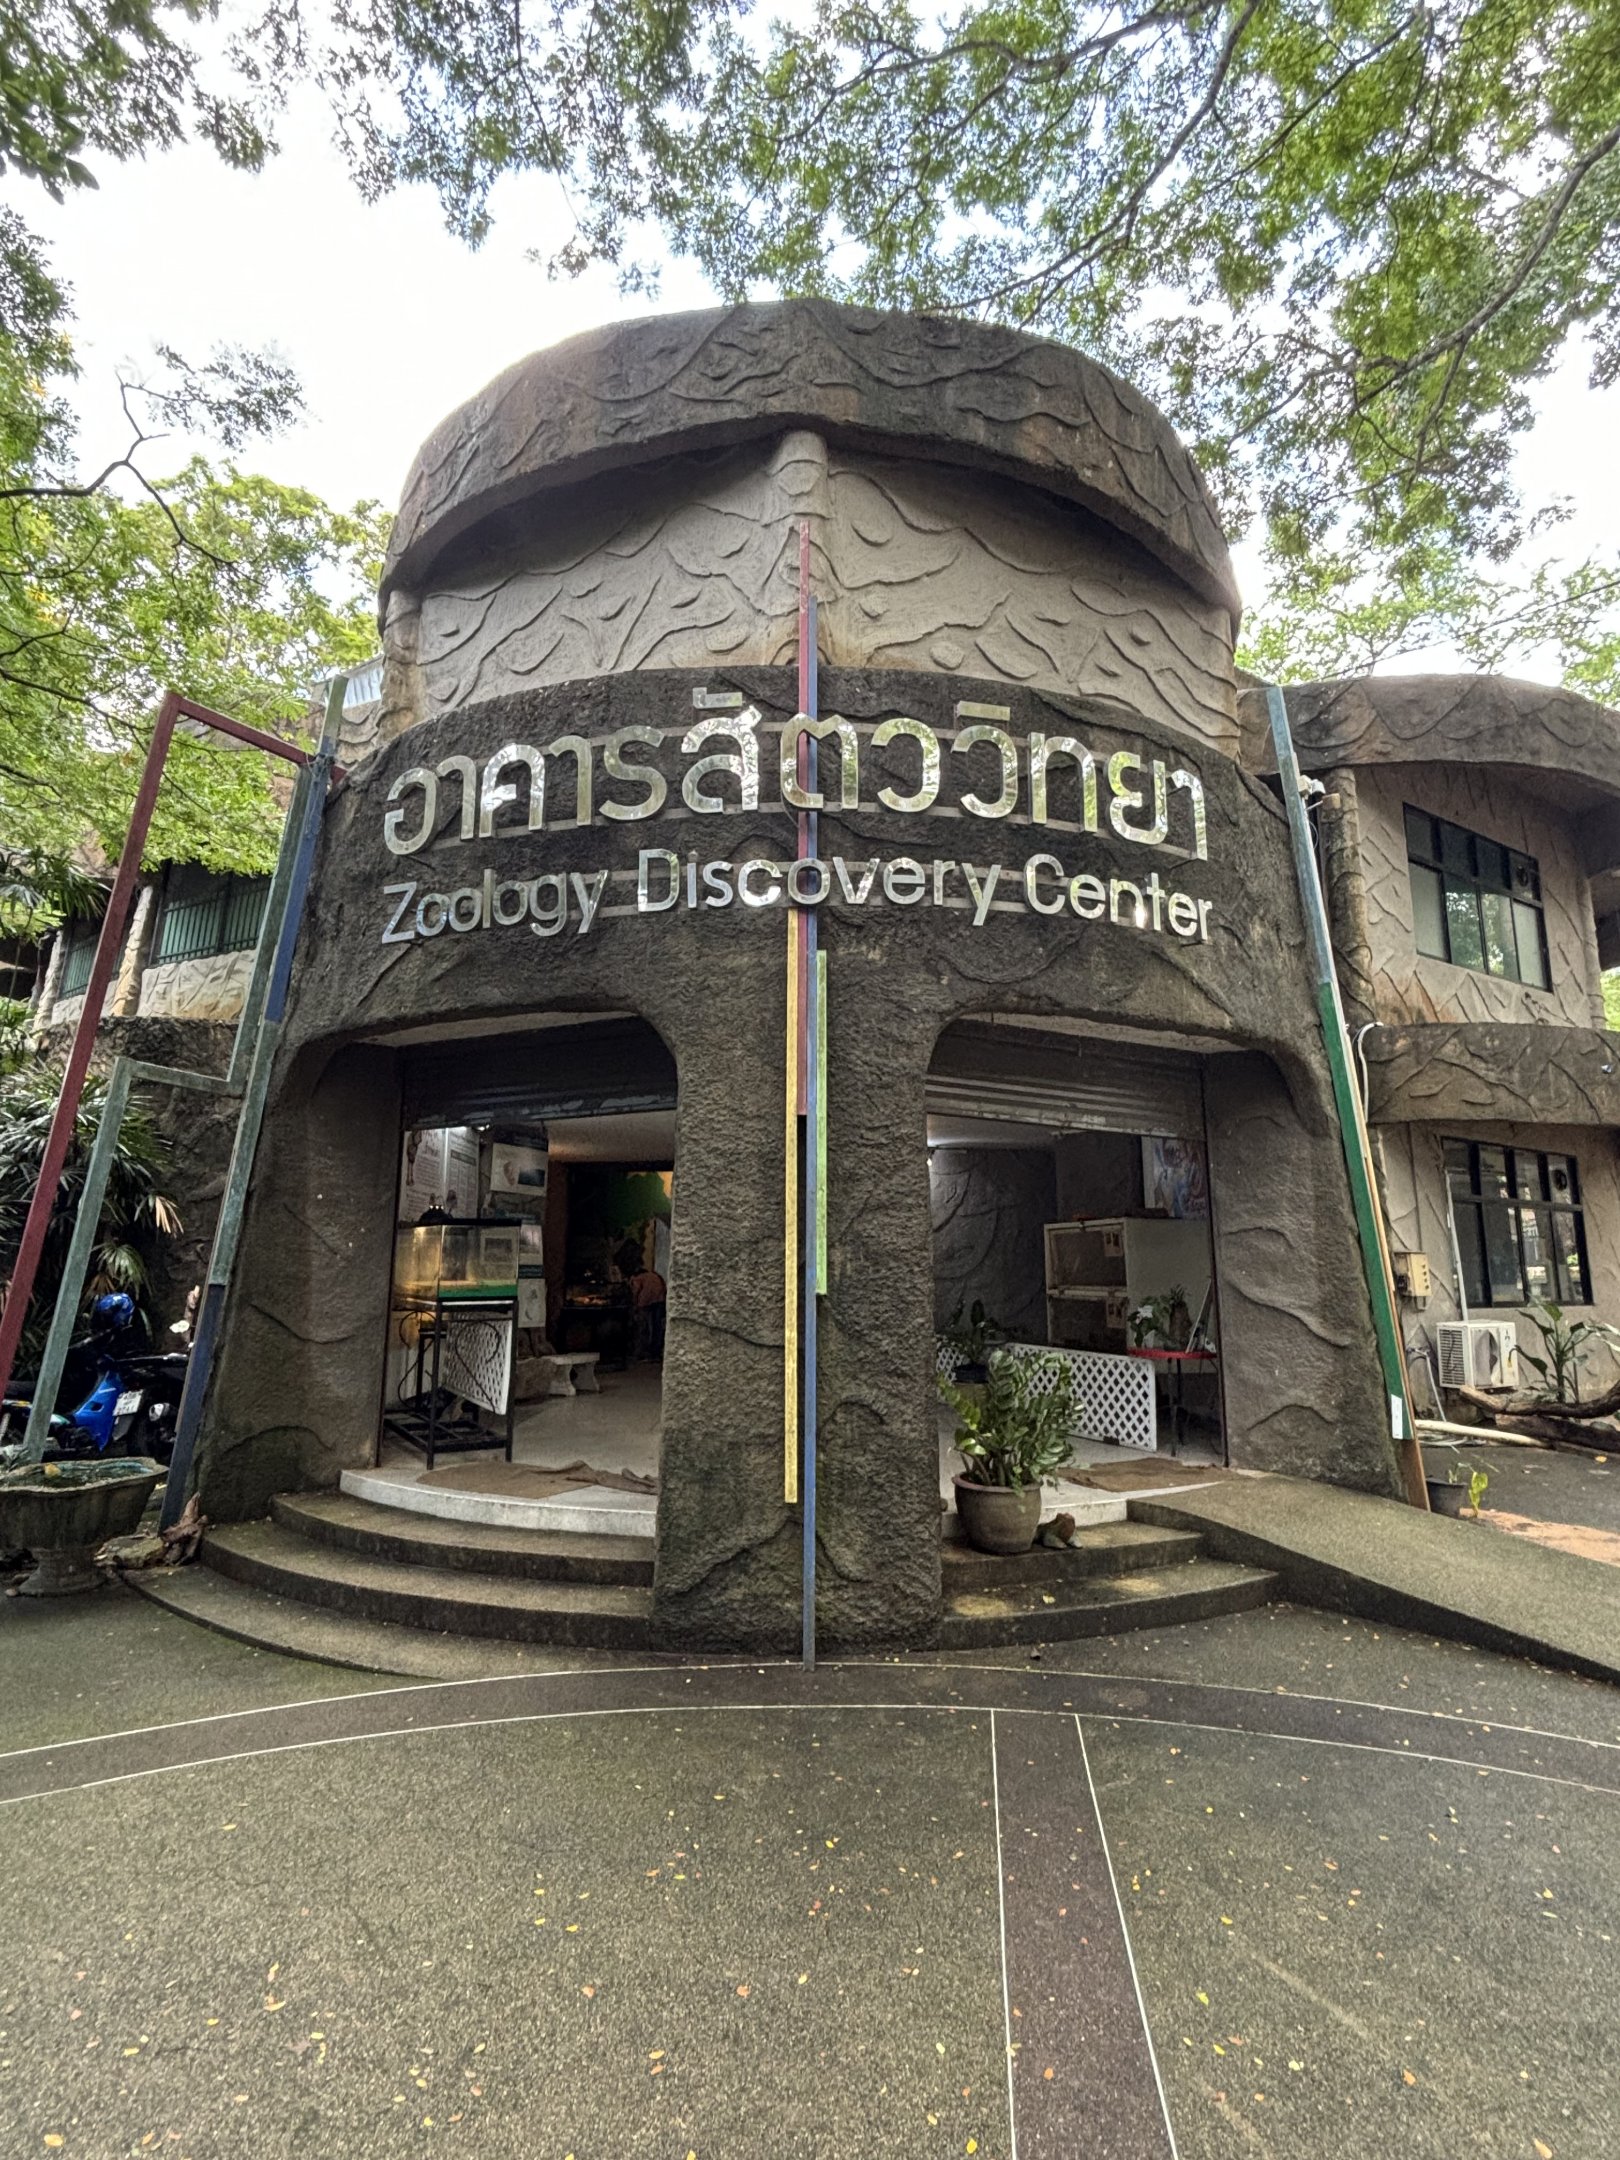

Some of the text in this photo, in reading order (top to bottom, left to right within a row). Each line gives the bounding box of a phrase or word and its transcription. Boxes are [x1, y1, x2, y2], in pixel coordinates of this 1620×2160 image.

[383, 687, 1208, 861] อาคารสัตววิทยา
[382, 848, 1213, 944] Zoology Discovery Center
